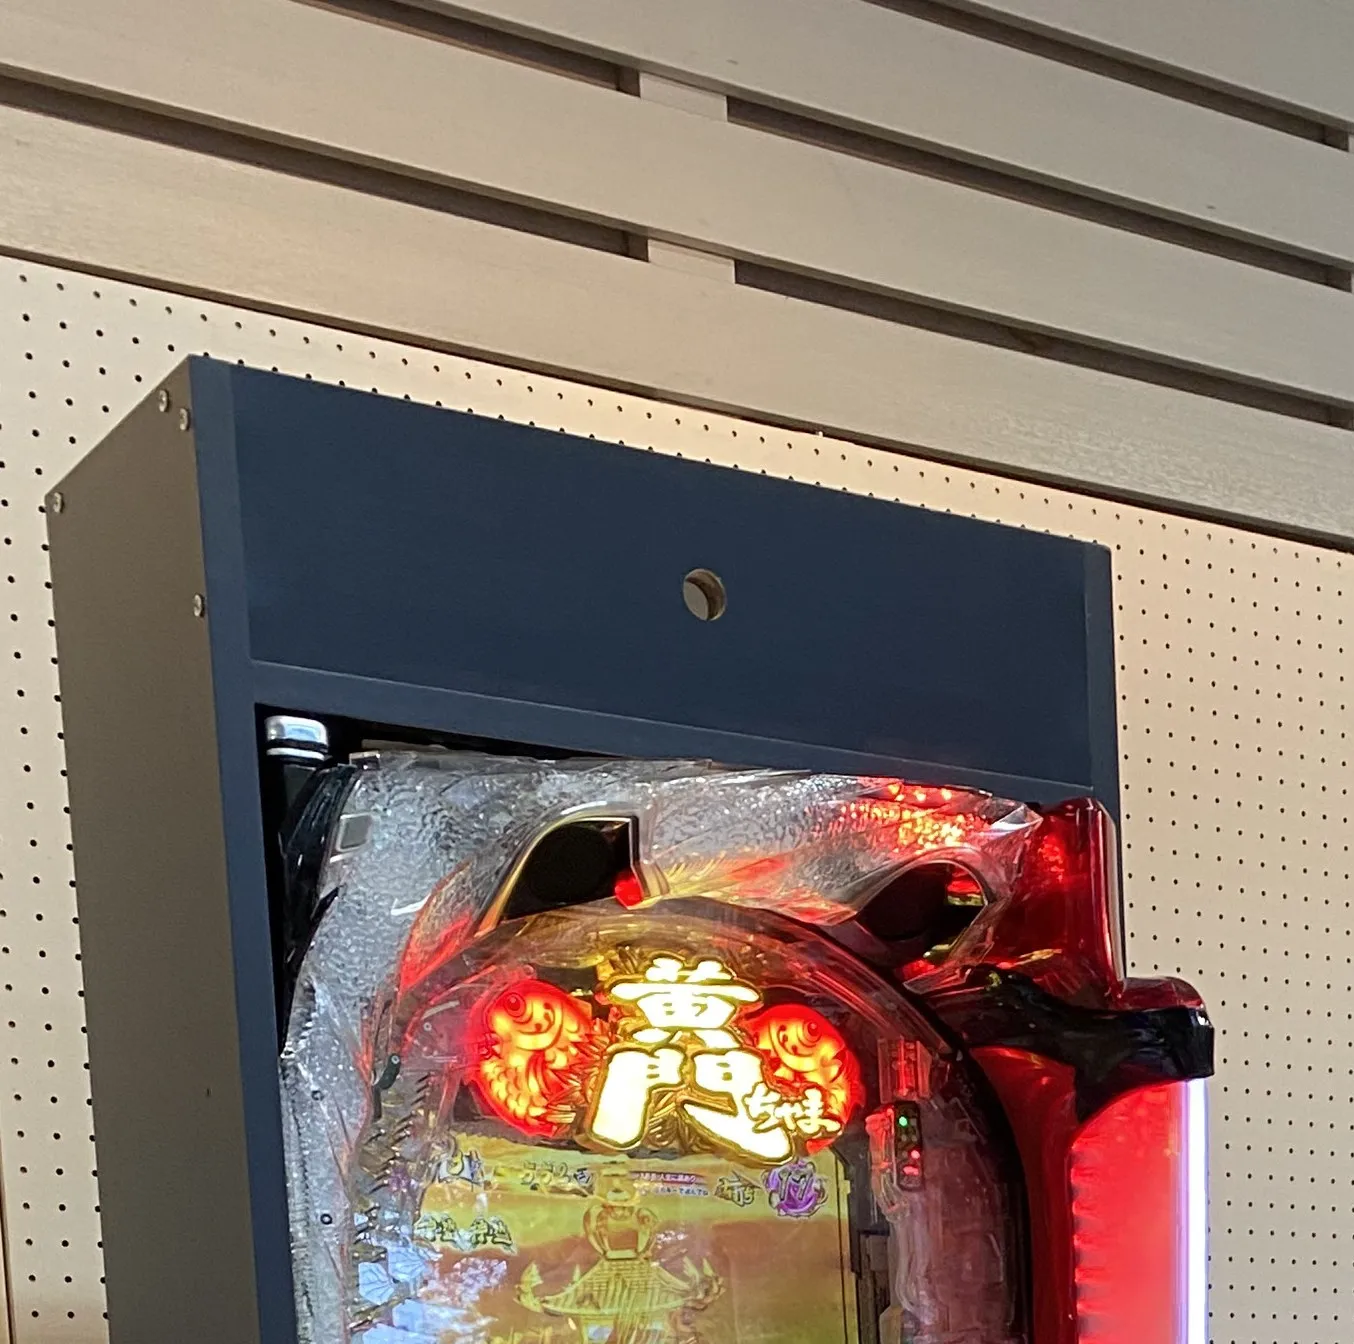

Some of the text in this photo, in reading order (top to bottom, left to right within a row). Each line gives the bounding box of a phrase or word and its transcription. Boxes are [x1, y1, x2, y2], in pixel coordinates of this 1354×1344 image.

[590, 956, 793, 1161] 黄門
[745, 1083, 842, 1135] ちゃま
